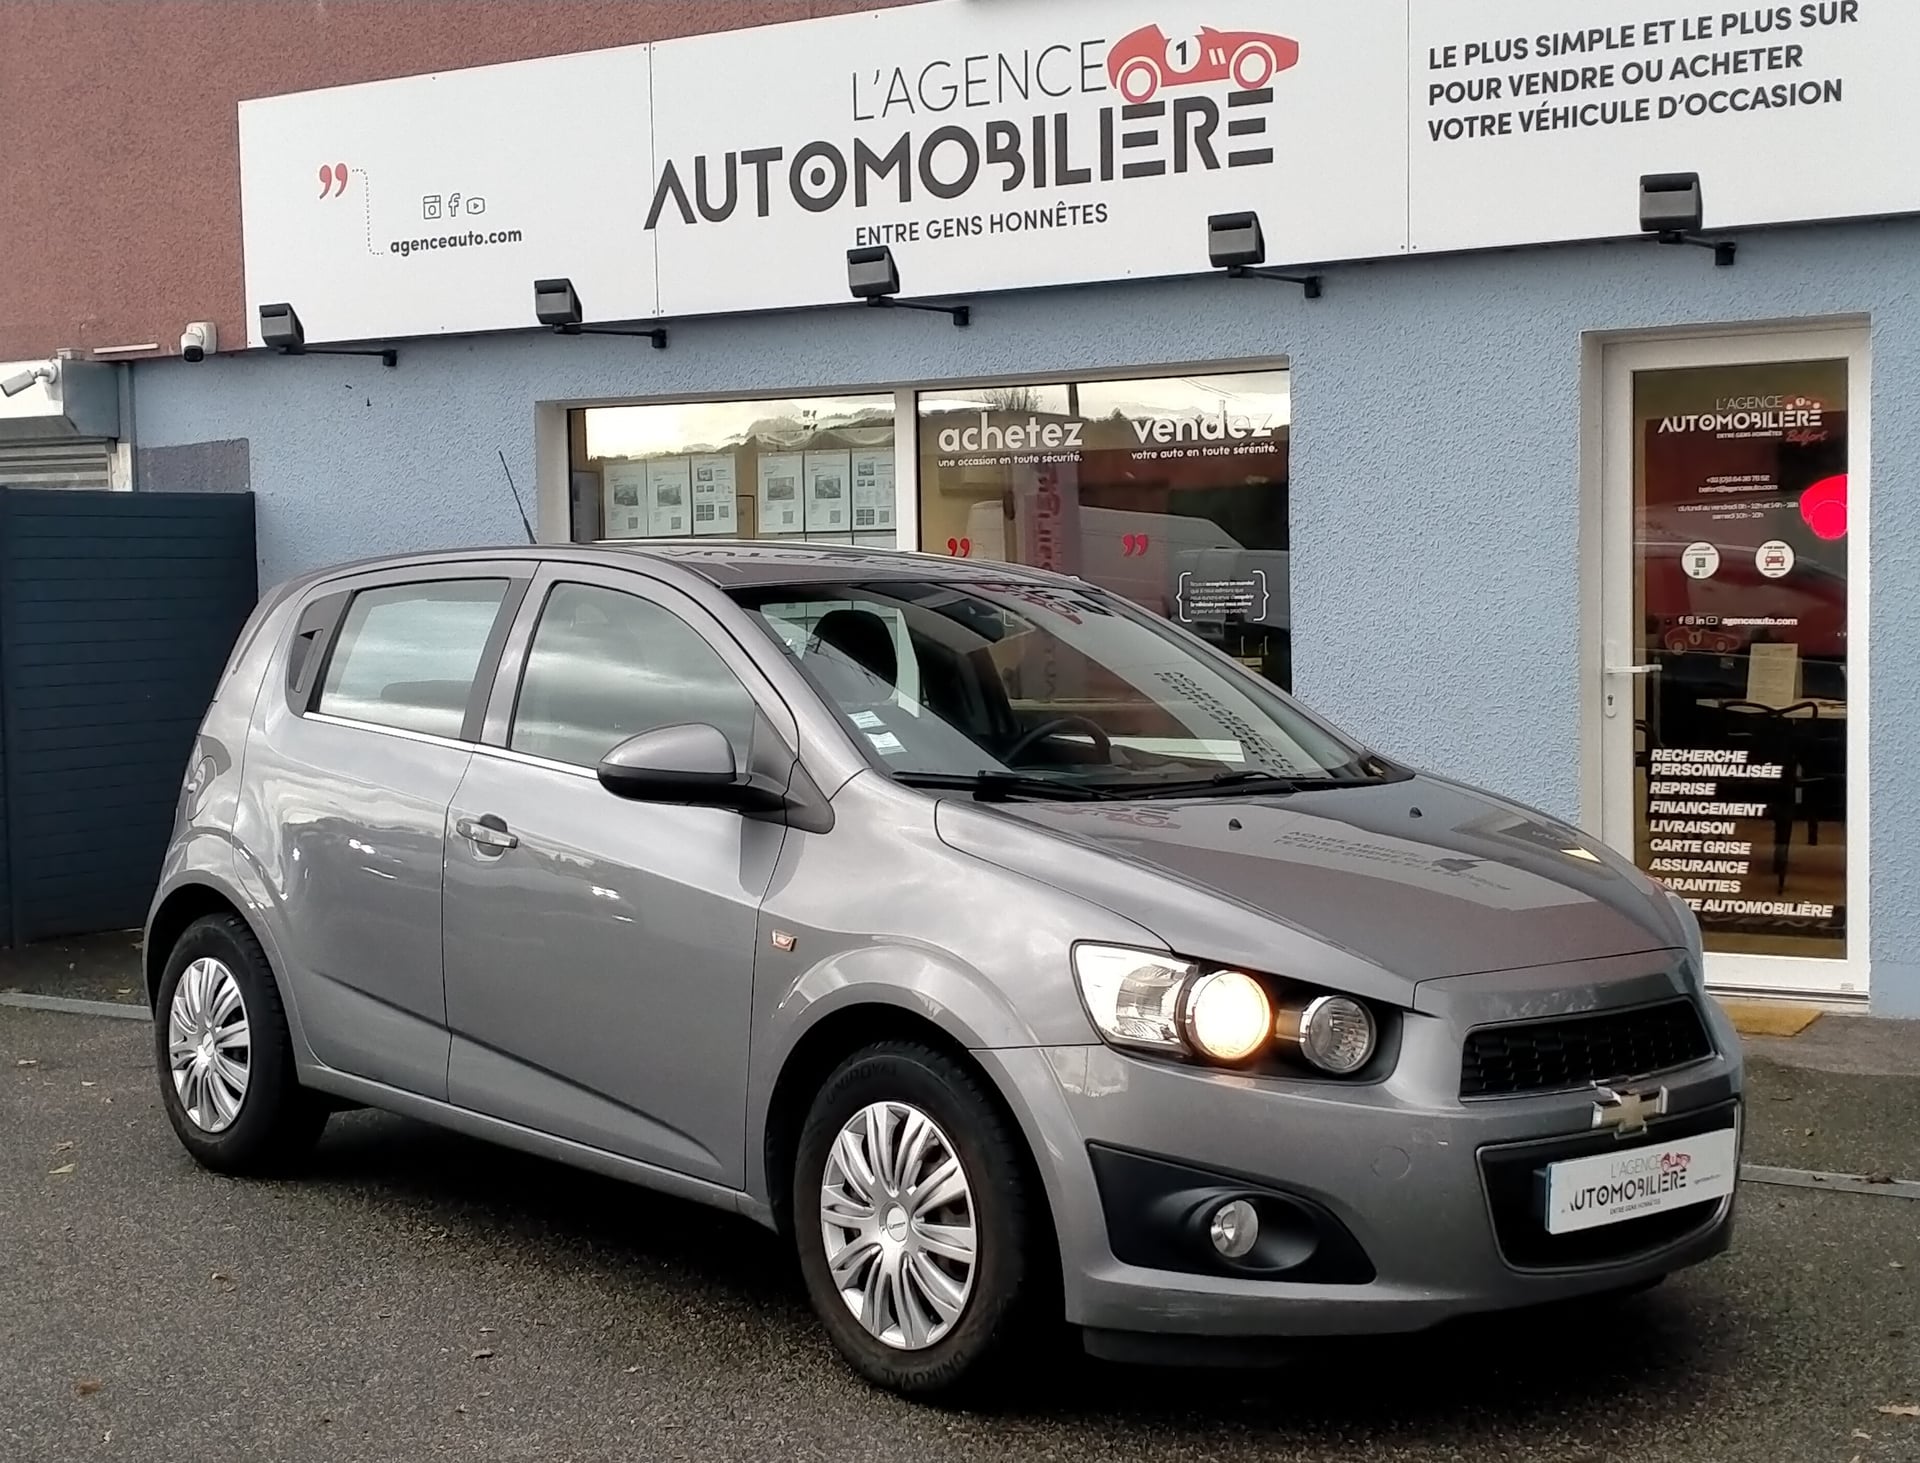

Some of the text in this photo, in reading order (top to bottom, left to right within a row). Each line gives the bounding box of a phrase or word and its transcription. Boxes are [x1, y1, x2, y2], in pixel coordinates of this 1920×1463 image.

[1429, 0, 1859, 70] LE PLUS SIMPLE ET LE PLUS SUR
[852, 38, 1107, 122] L'AGENCE
[1429, 43, 1803, 106] POUR VENDRE OU ACHETER
[1428, 78, 1843, 143] VOTRE VÉHICULE D'OCCASION
[855, 200, 1109, 247] ENTRE GENS HONNÊTES
[390, 227, 523, 257] agenceauto.com
[1131, 400, 1273, 444] vendez
[938, 411, 1083, 452] achetez
[938, 458, 956, 467] une
[958, 454, 997, 466] occasion
[1000, 456, 1011, 465] en
[1013, 454, 1040, 464] toute
[1131, 450, 1158, 460] votre
[1160, 448, 1184, 459] auto
[1187, 448, 1200, 457] en
[1202, 446, 1231, 457] toute
[1650, 748, 1749, 763] RECHERCHE
[1650, 762, 1784, 778] PERSONNALISÉE
[1649, 781, 1717, 796] REPRISE
[1649, 801, 1767, 817] FINANCEMENT
[1650, 819, 1736, 835] LIVRAISON
[1650, 838, 1752, 855] CARTE GRISE
[1649, 858, 1750, 875] ASSURANCE
[1654, 876, 1742, 893] ARANTIES
[1703, 898, 1834, 918] AUTOMOBILIÈRE
